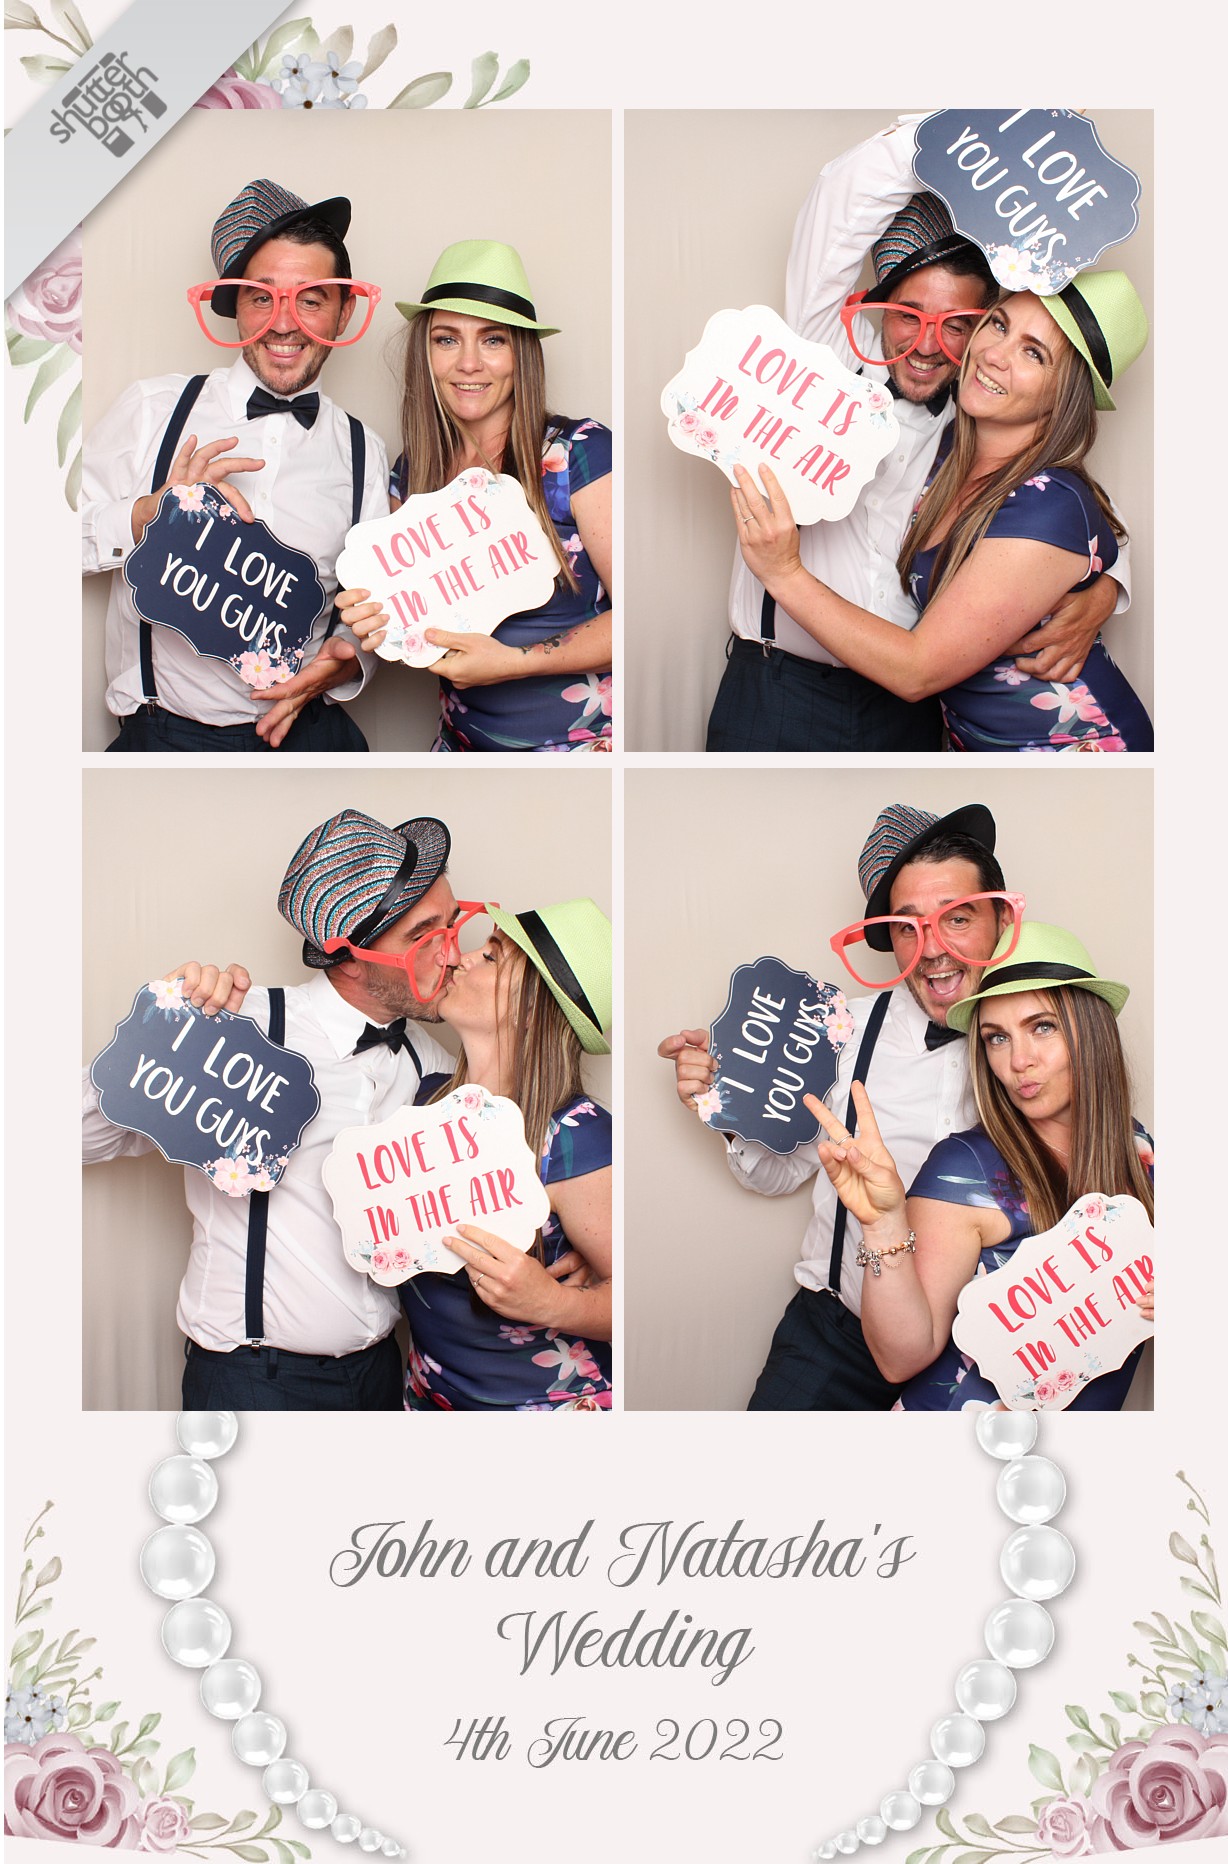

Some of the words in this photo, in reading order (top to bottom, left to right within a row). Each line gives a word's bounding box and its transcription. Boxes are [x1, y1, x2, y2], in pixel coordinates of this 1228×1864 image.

[946, 126, 1009, 191] YOU
[995, 185, 1067, 266] GUYS
[998, 109, 1033, 133] I
[1021, 130, 1109, 221] LOVE
[738, 335, 825, 411] LOVE
[818, 388, 862, 436] IS
[743, 404, 801, 460] THE
[792, 444, 851, 496] AIR
[195, 517, 215, 551] I
[224, 537, 299, 608] LOVE
[372, 513, 454, 577] LOVE
[450, 494, 492, 537] IS
[429, 555, 485, 606] THE
[488, 530, 539, 580] AIR
[160, 552, 220, 612] YOU
[220, 594, 287, 659] GUYS
[171, 1015, 196, 1052] I
[203, 1036, 290, 1114] LOVE
[732, 986, 786, 1064] LOVE
[783, 998, 830, 1065] GUYS
[129, 1053, 197, 1116] YOU
[195, 1097, 271, 1166] GUYS
[720, 1076, 755, 1094] I
[762, 1066, 805, 1123] YOU
[356, 1130, 435, 1190] LOVE
[439, 1115, 480, 1164] IS
[405, 1184, 460, 1233] THE
[470, 1167, 523, 1217] AIR
[988, 1255, 1075, 1333] LOVE
[1068, 1226, 1113, 1274] IS
[1053, 1292, 1113, 1347] THE
